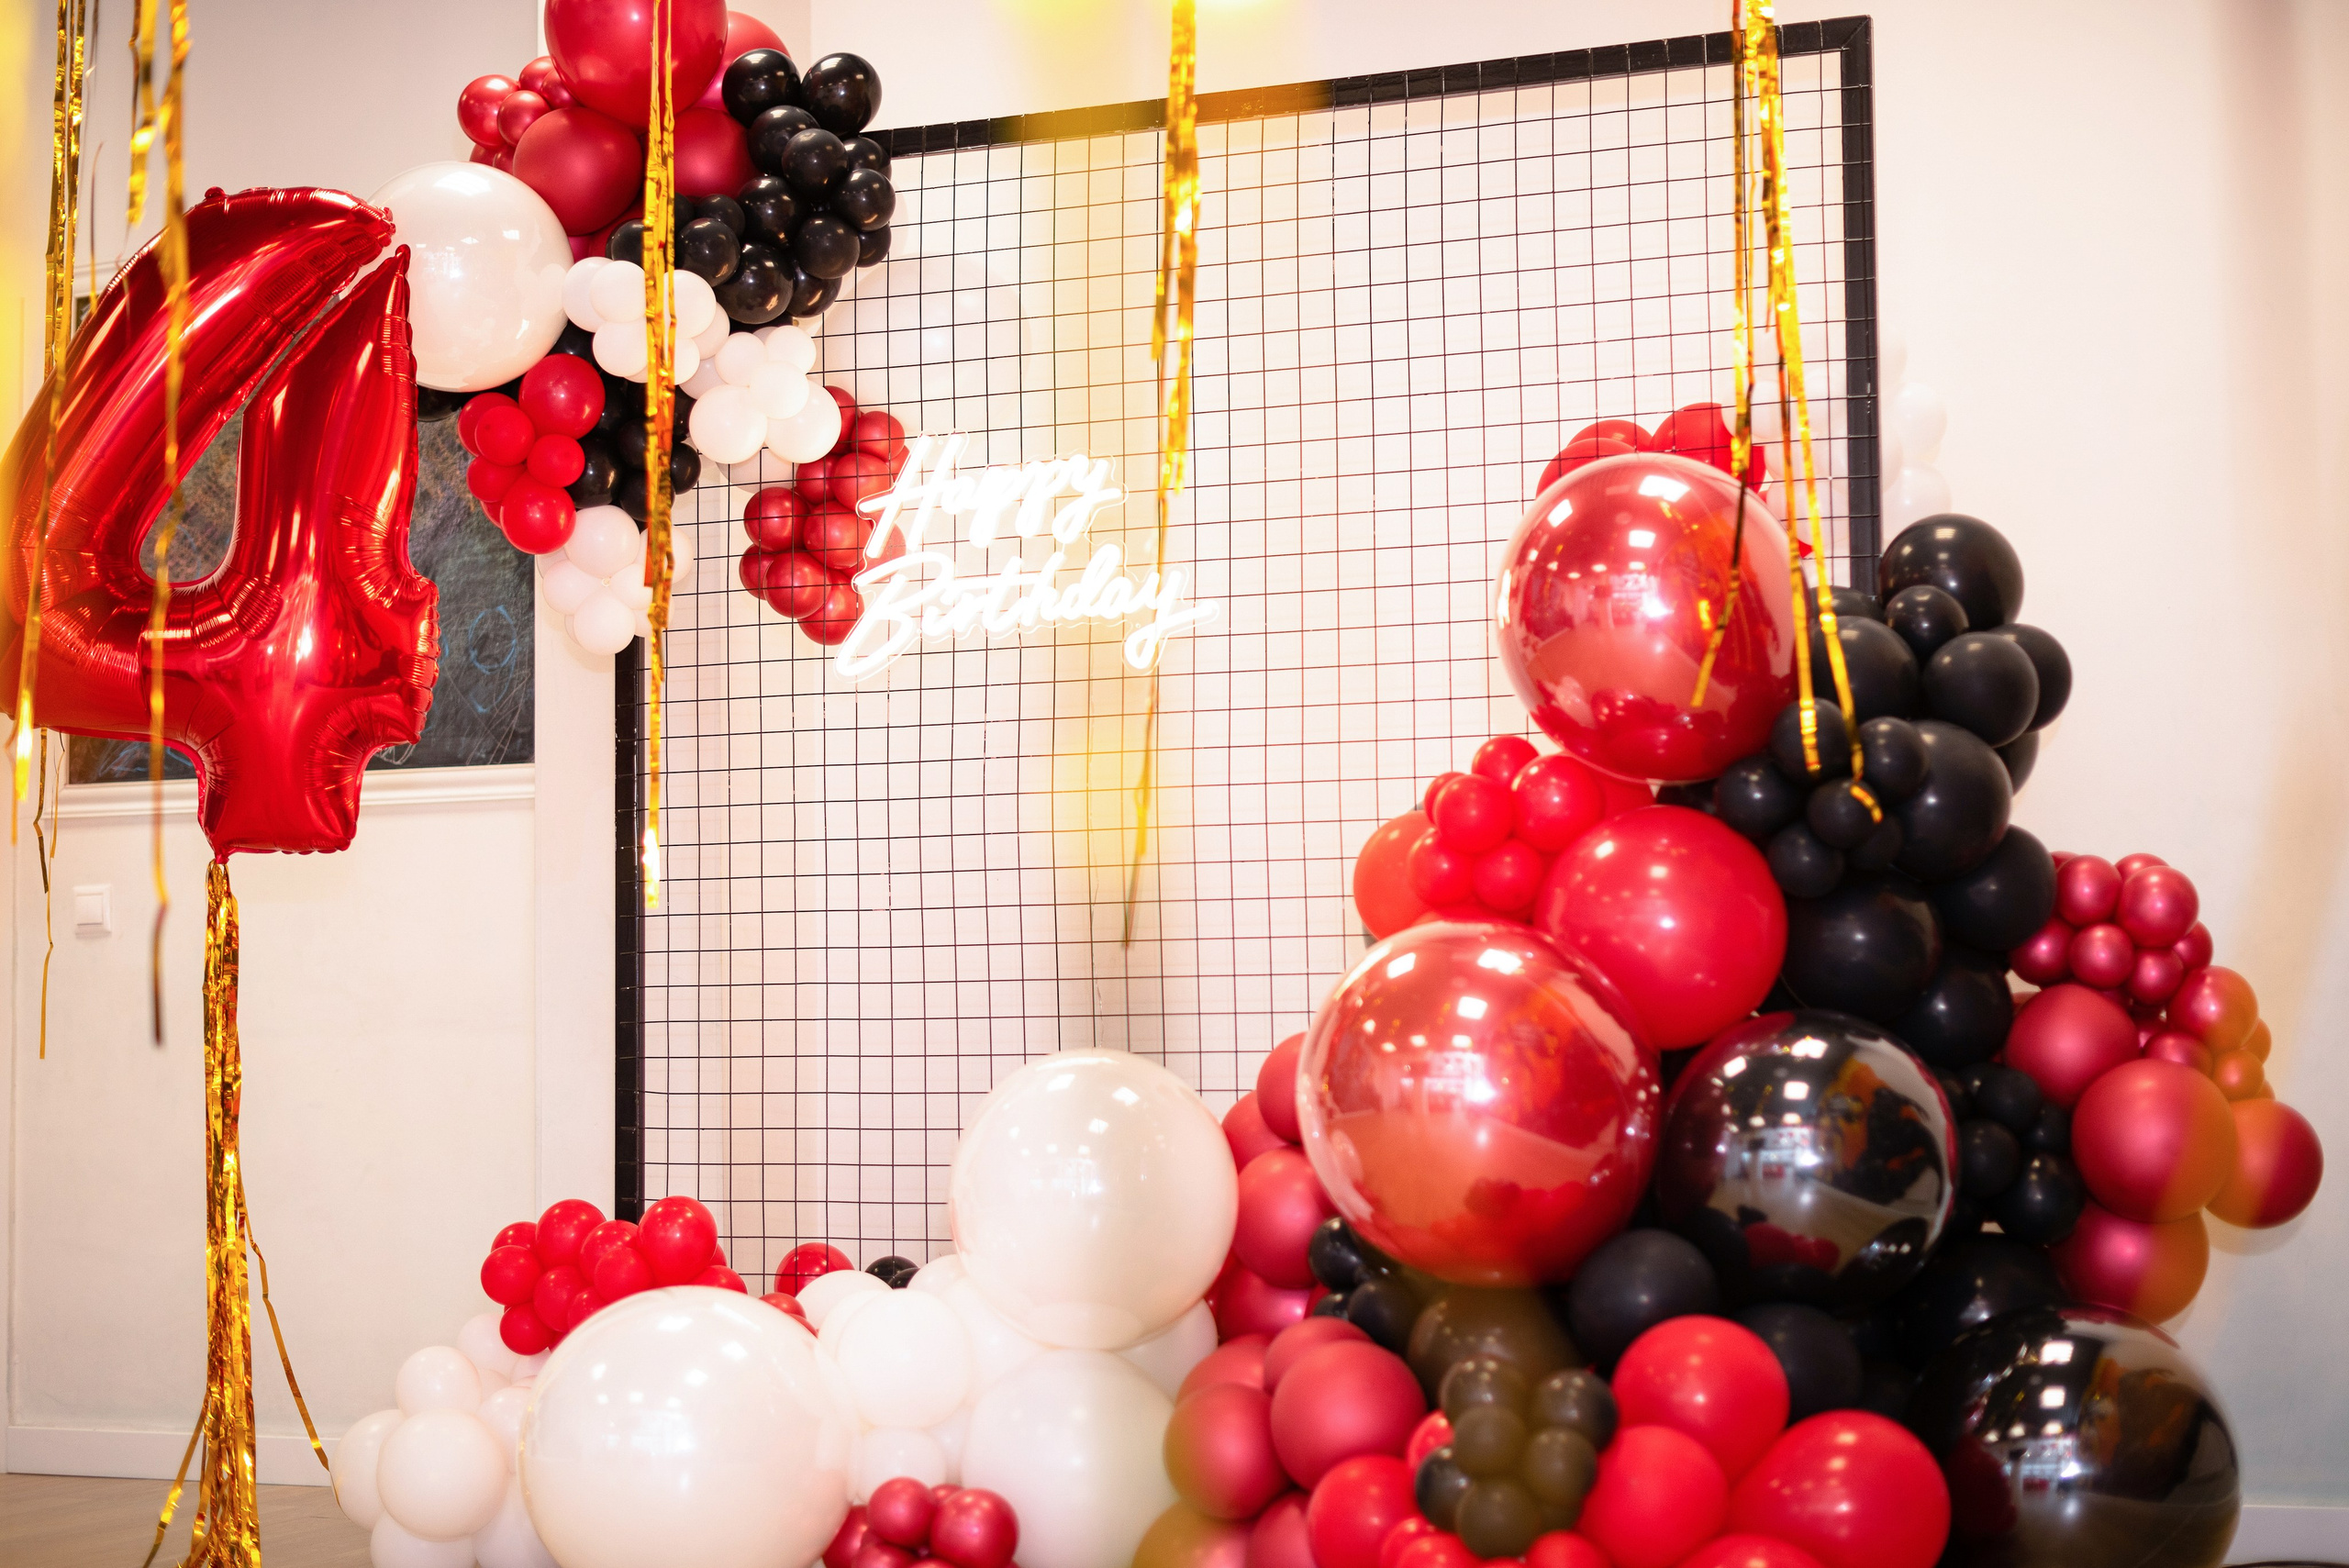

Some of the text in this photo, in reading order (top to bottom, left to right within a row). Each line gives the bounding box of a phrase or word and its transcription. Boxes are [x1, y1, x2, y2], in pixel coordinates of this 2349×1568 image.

[0, 183, 440, 859] 4
[857, 431, 1124, 550] Happy
[833, 541, 1222, 681] Birthday
